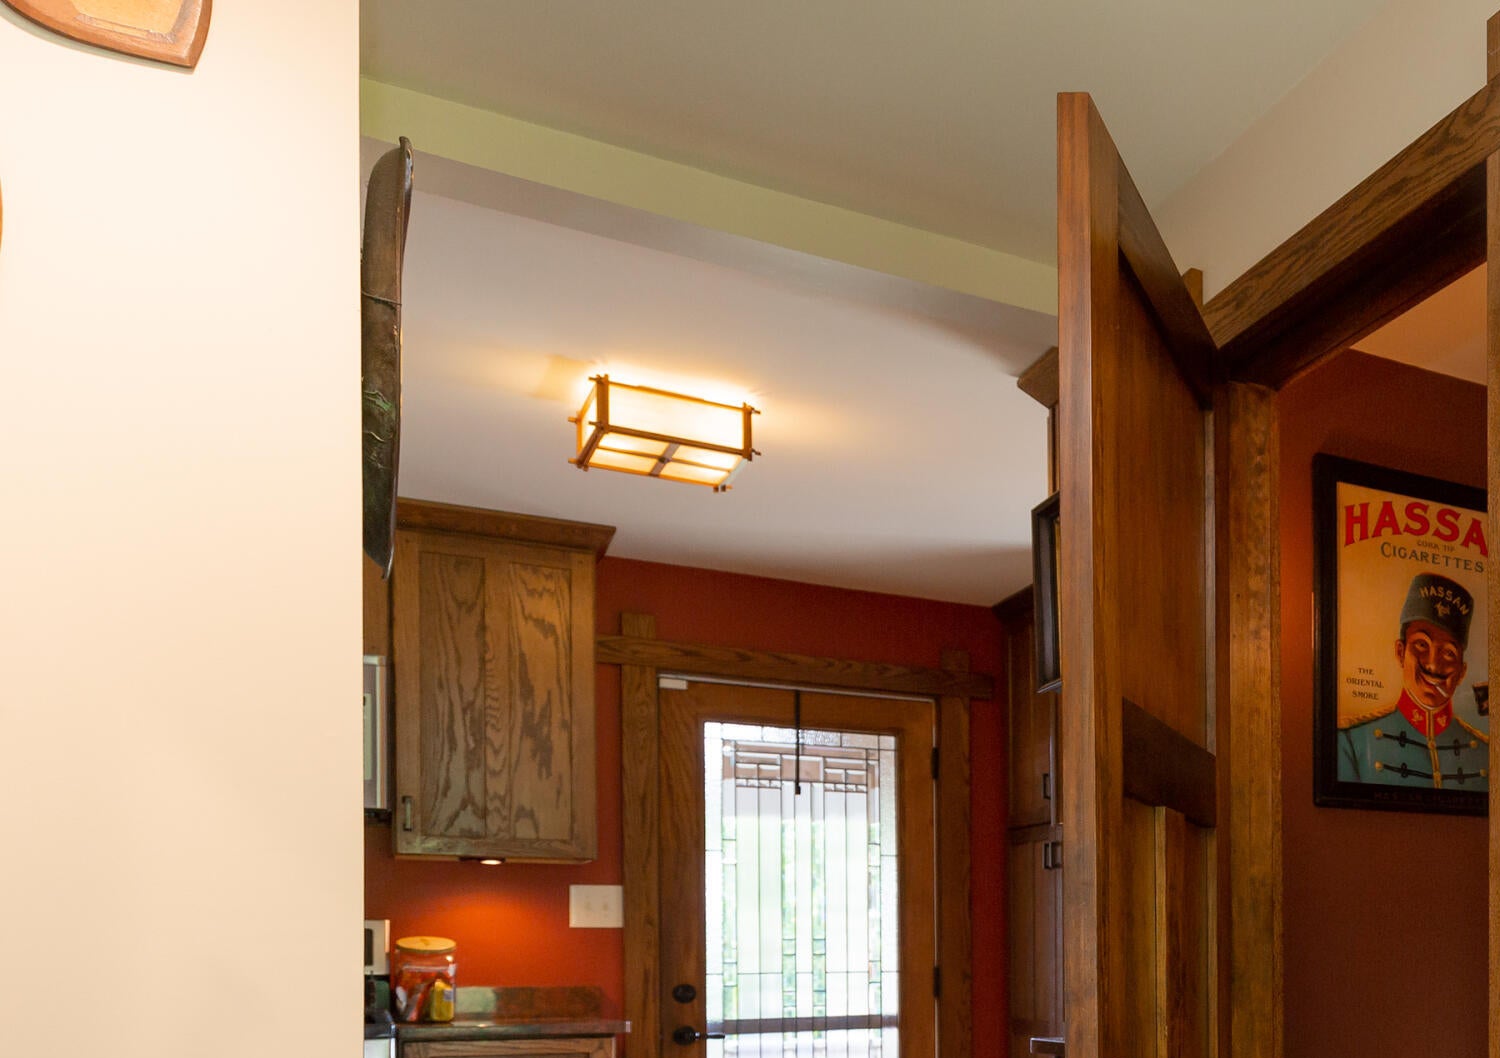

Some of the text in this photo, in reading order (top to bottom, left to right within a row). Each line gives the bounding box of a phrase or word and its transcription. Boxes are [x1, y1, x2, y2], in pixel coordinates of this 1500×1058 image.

[1380, 542, 1485, 573] CIGARETTES
[1419, 585, 1469, 615] HASSAN
[1358, 667, 1375, 676] THE
[1346, 677, 1385, 689] ORIENTAL
[1352, 690, 1380, 700] SMOKE
